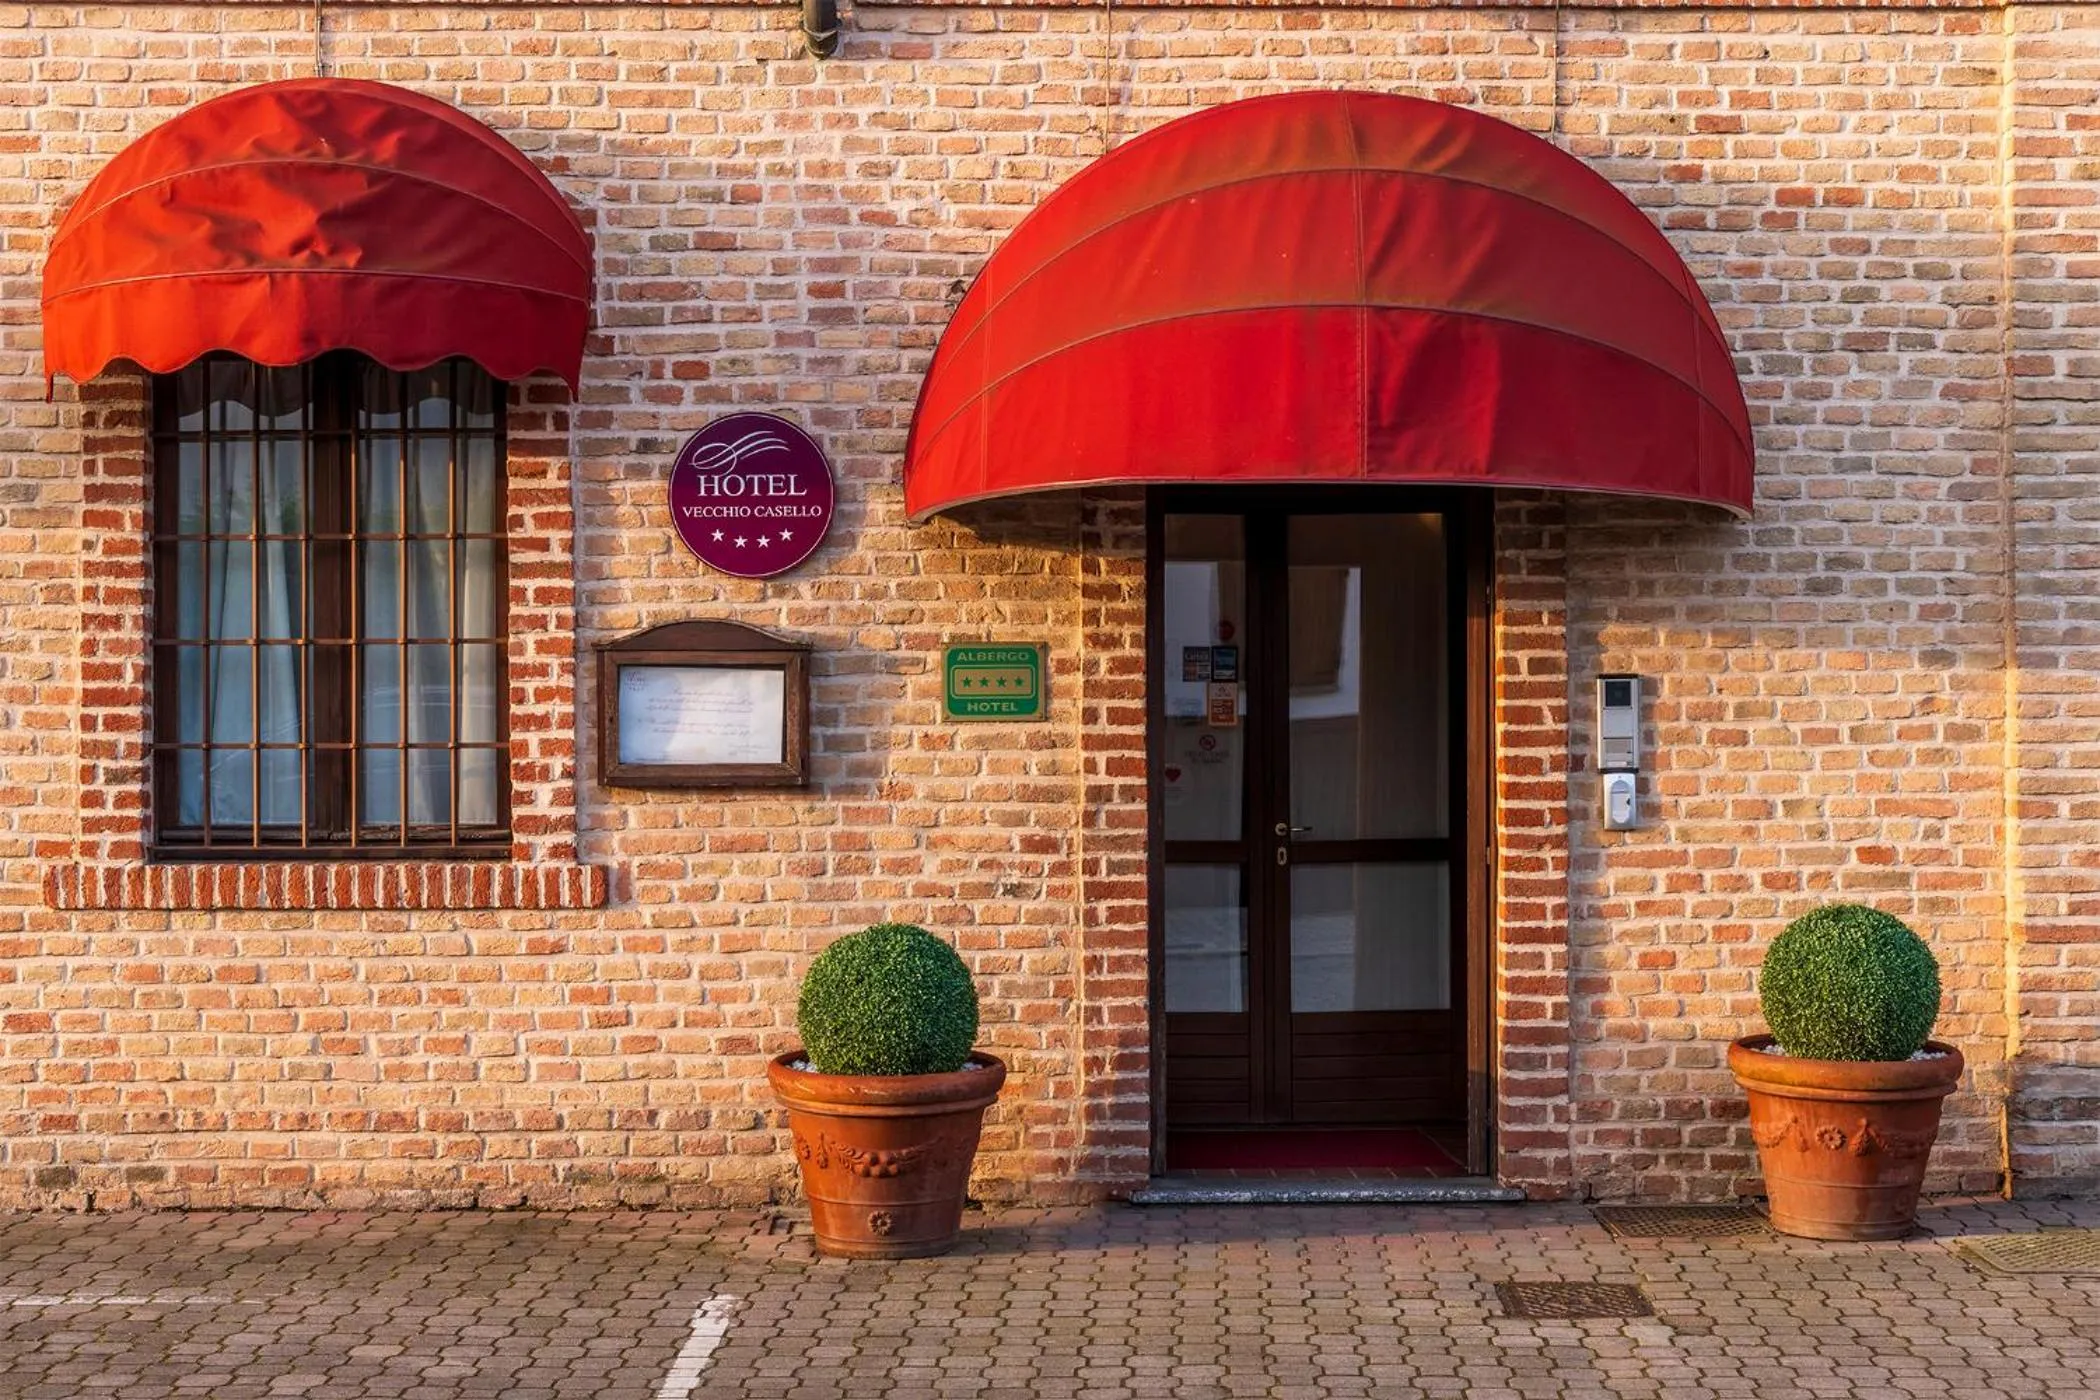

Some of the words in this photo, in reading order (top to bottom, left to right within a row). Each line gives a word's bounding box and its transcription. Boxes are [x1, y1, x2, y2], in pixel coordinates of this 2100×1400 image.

[697, 474, 807, 496] HOTEL
[682, 505, 750, 517] VECCHIO
[754, 505, 822, 517] CASELLO
[957, 652, 1028, 661] ALBERGO
[967, 702, 1018, 712] HOTEL
